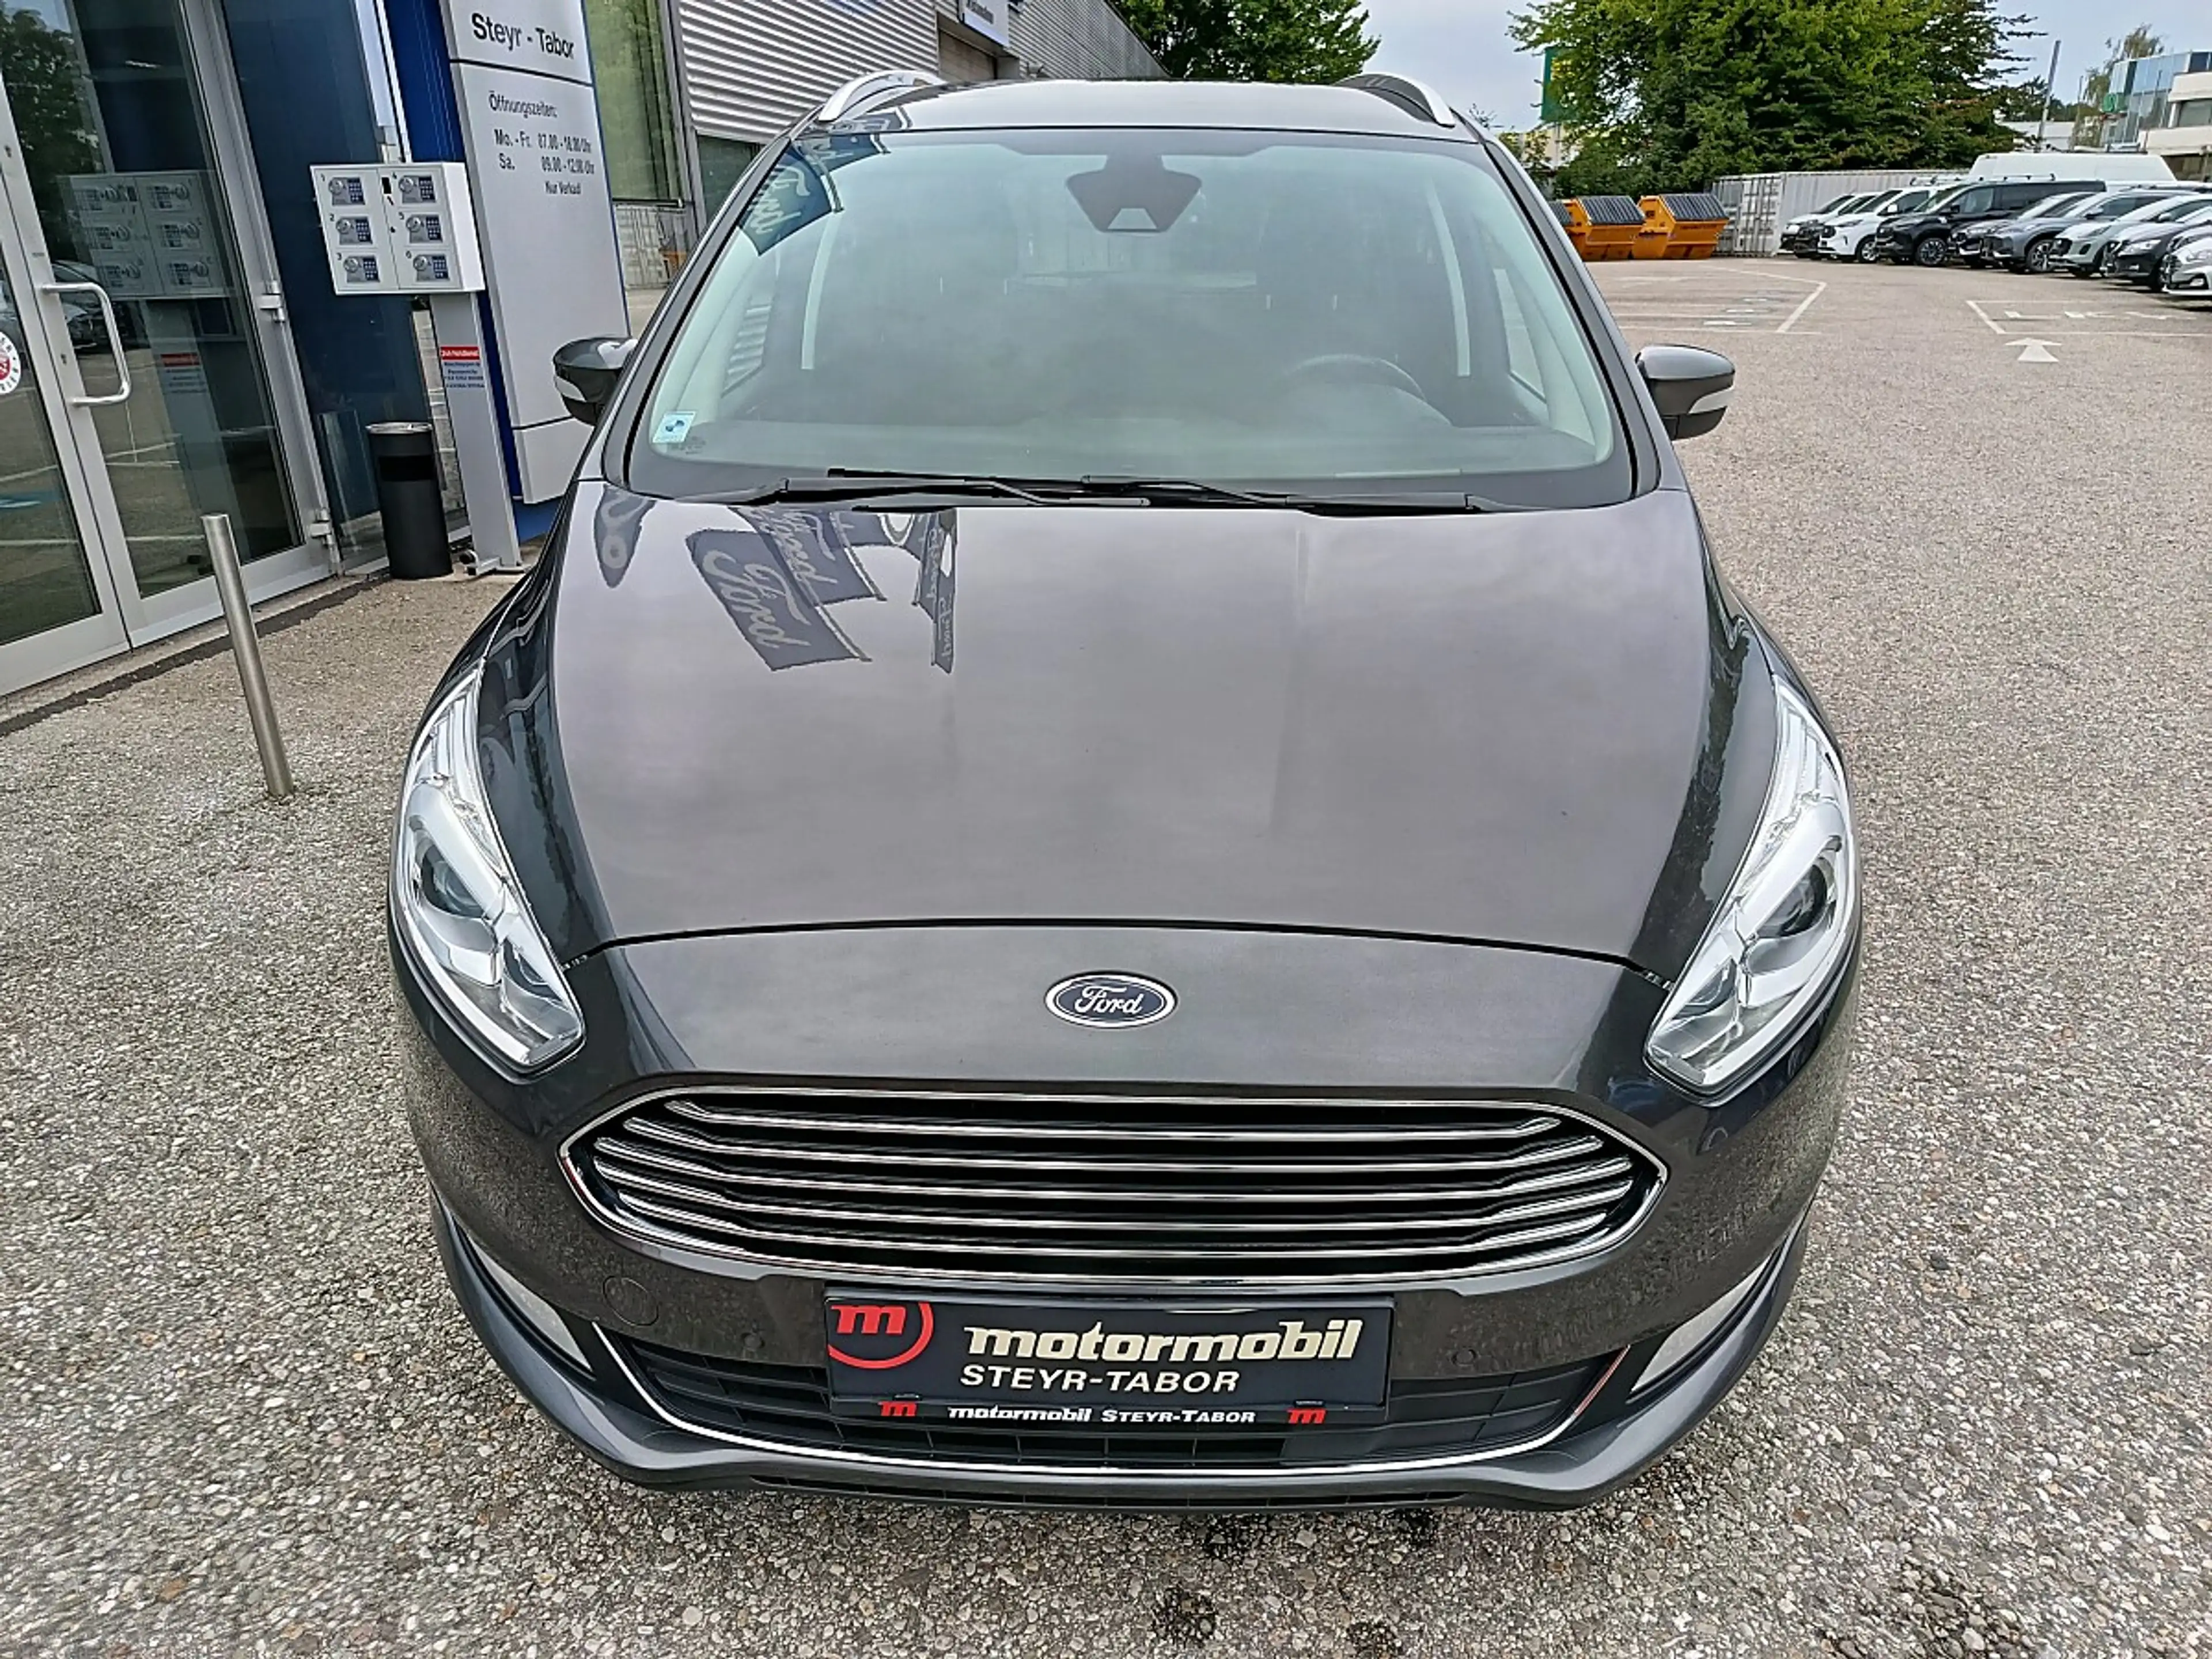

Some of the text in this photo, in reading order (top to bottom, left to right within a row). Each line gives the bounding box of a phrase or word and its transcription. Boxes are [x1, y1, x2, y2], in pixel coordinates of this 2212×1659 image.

[472, 13, 521, 51] Steyr
[535, 27, 574, 59] Tabor
[489, 90, 558, 119] Öffnungszeiten:
[494, 128, 513, 146] Mo.
[499, 153, 515, 170] Sa.
[329, 213, 335, 222] 2
[399, 211, 405, 220] 5
[337, 252, 342, 260] 3
[702, 550, 812, 649] Ford
[1074, 986, 1145, 1014] Ford
[831, 1304, 907, 1335] m
[964, 1319, 1363, 1362] motormobil
[960, 1364, 1240, 1393] STEYR-TABOR
[948, 1404, 1092, 1422] motormobil
[1101, 1410, 1256, 1423] STEYR-TABOR
